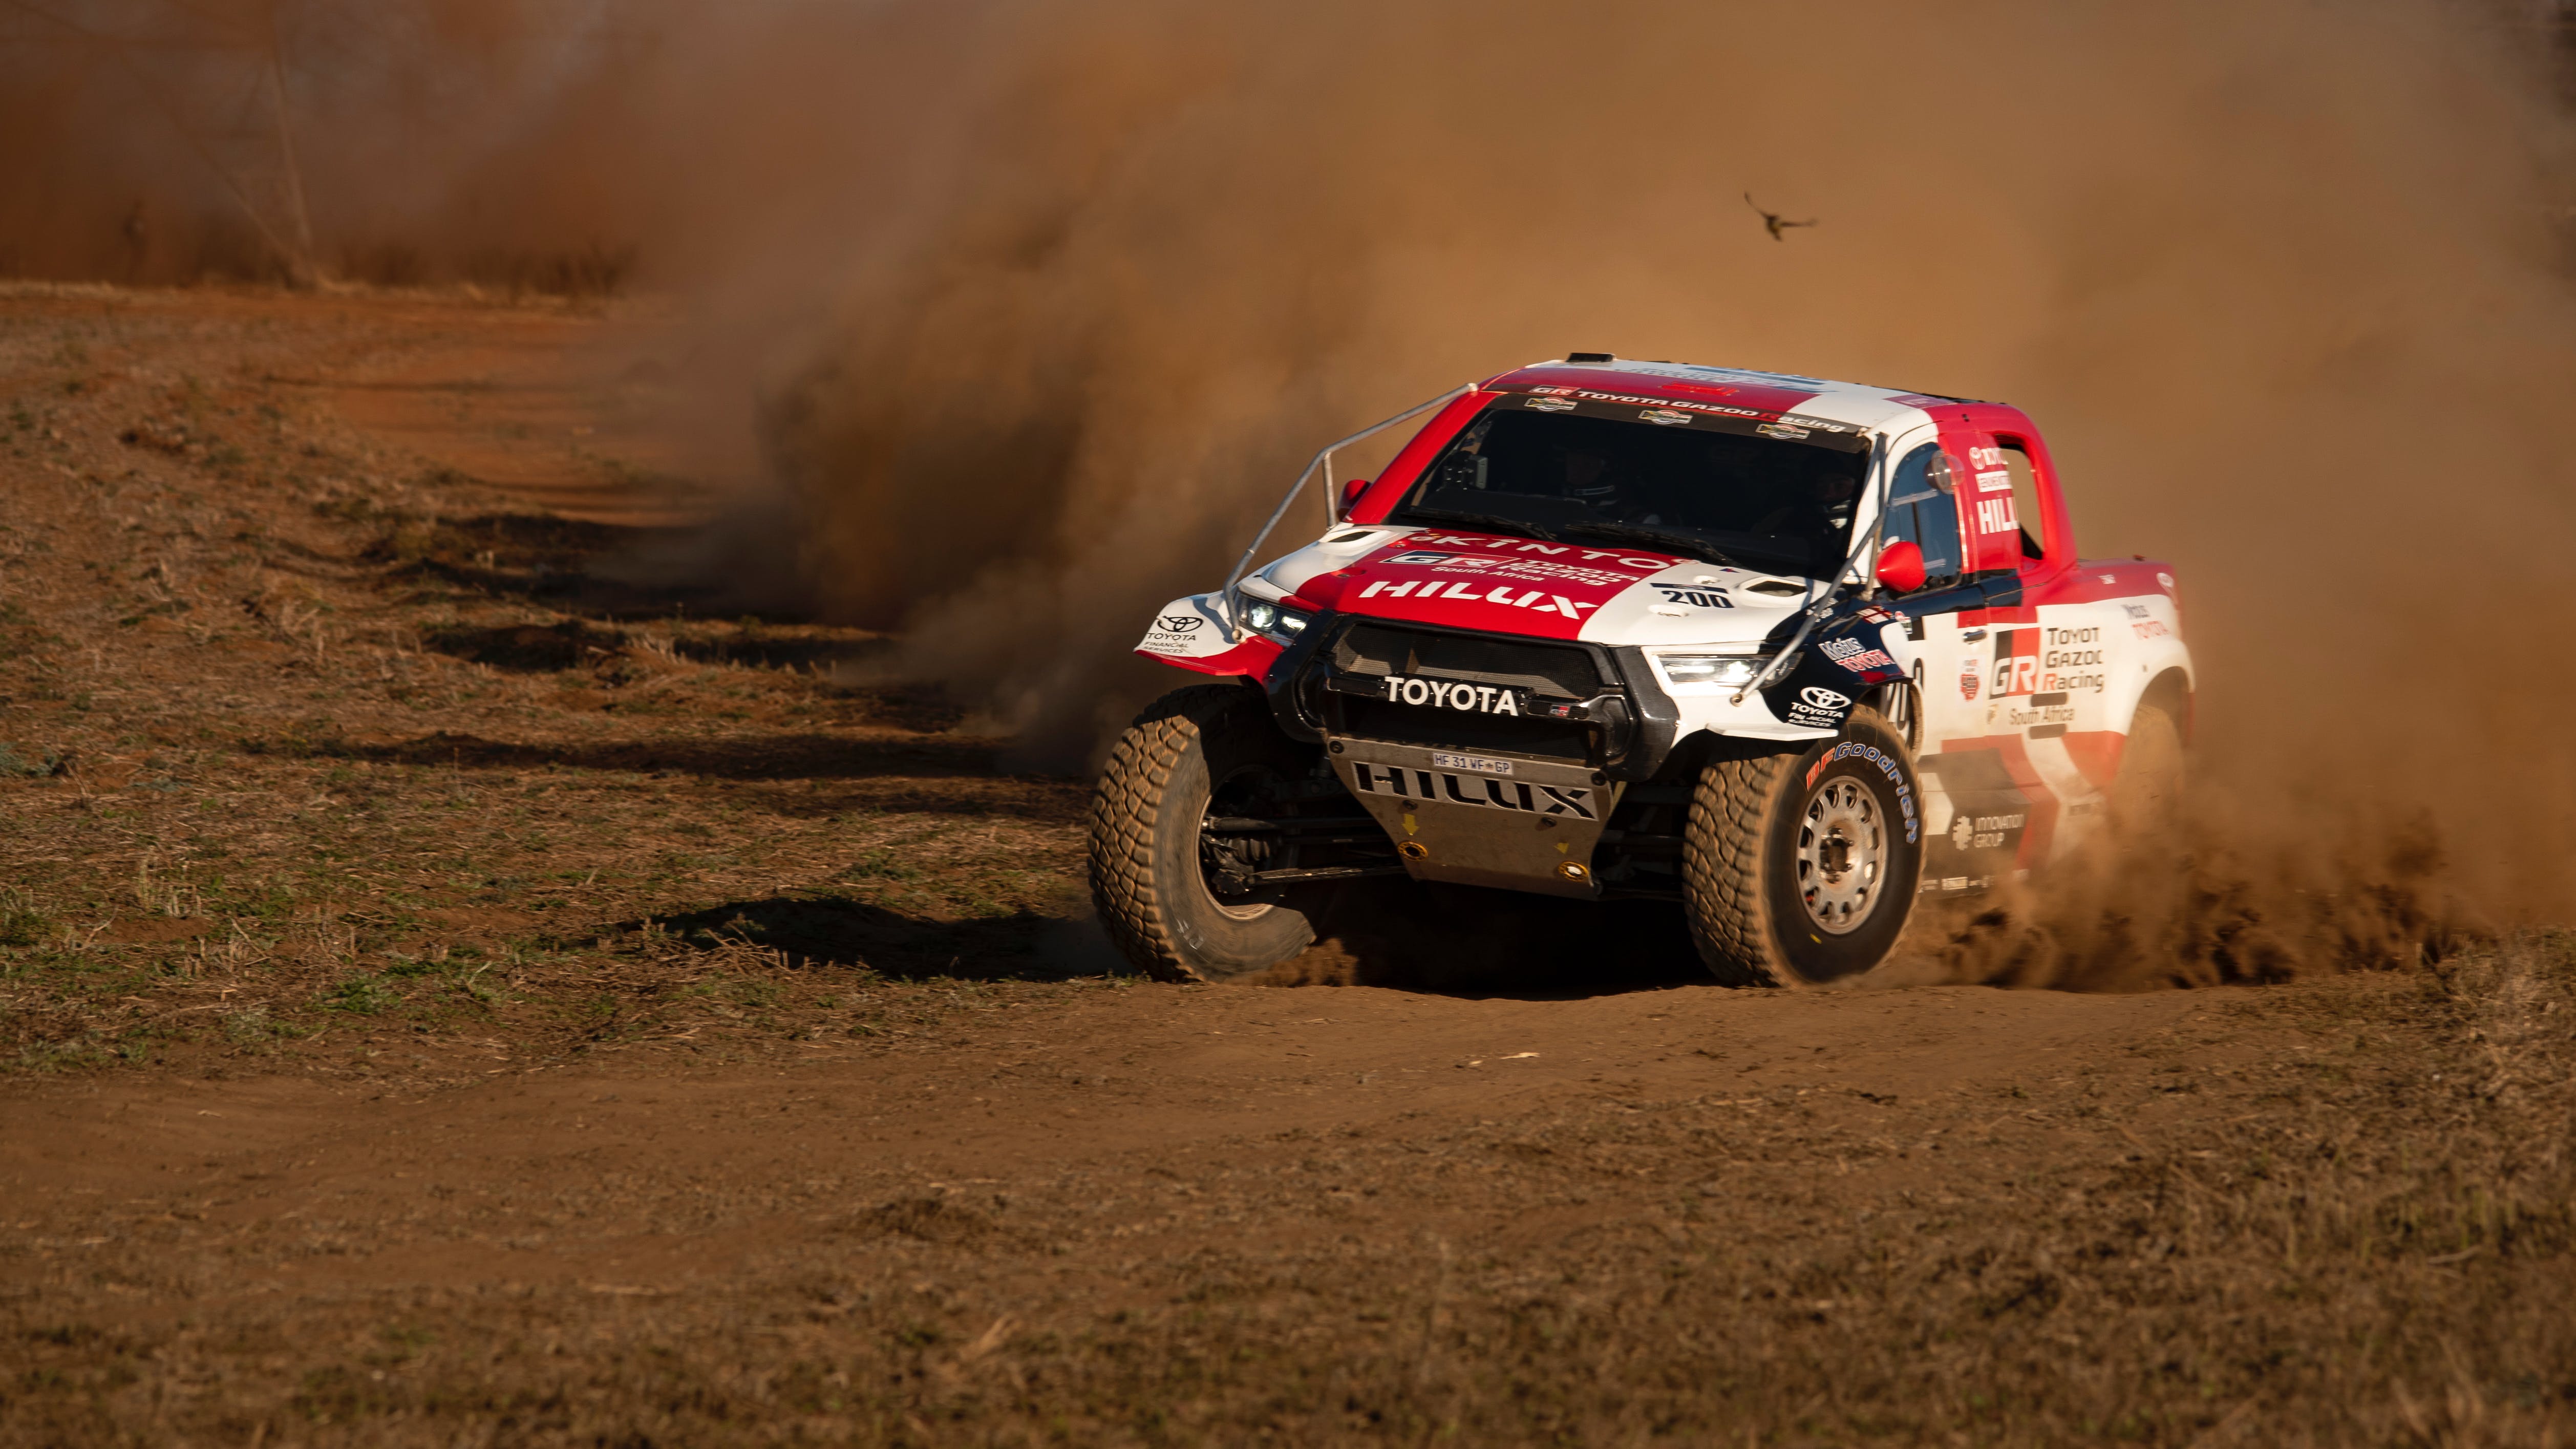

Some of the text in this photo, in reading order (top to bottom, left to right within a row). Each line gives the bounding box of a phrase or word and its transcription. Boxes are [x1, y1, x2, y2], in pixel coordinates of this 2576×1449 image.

[1530, 387, 1573, 396] GR
[1578, 391, 1669, 406] TOYOTA
[1670, 401, 1759, 417] GAZOO
[1757, 413, 1847, 433] Racing
[1389, 555, 1499, 567] GR
[1525, 560, 1642, 582] TOYOTA
[1431, 566, 1545, 581] South Africa
[1497, 565, 1608, 586] Racing
[1510, 563, 1622, 583] GAZOO
[1358, 581, 1600, 620] HILUX
[1661, 590, 1735, 609] 200
[2047, 627, 2100, 646] TOYOT
[1835, 649, 1896, 672] TOYOTA
[1991, 655, 2038, 696] GR
[2042, 670, 2105, 693] Racing
[1385, 676, 1519, 716] TOYOTA
[1791, 702, 1844, 718] TOYOTA
[1434, 754, 1509, 773] HF 31 WF GP
[1353, 762, 1596, 820] HILUX
[1975, 814, 2024, 831] INNOVATION
[1974, 833, 2005, 848] GROUP
